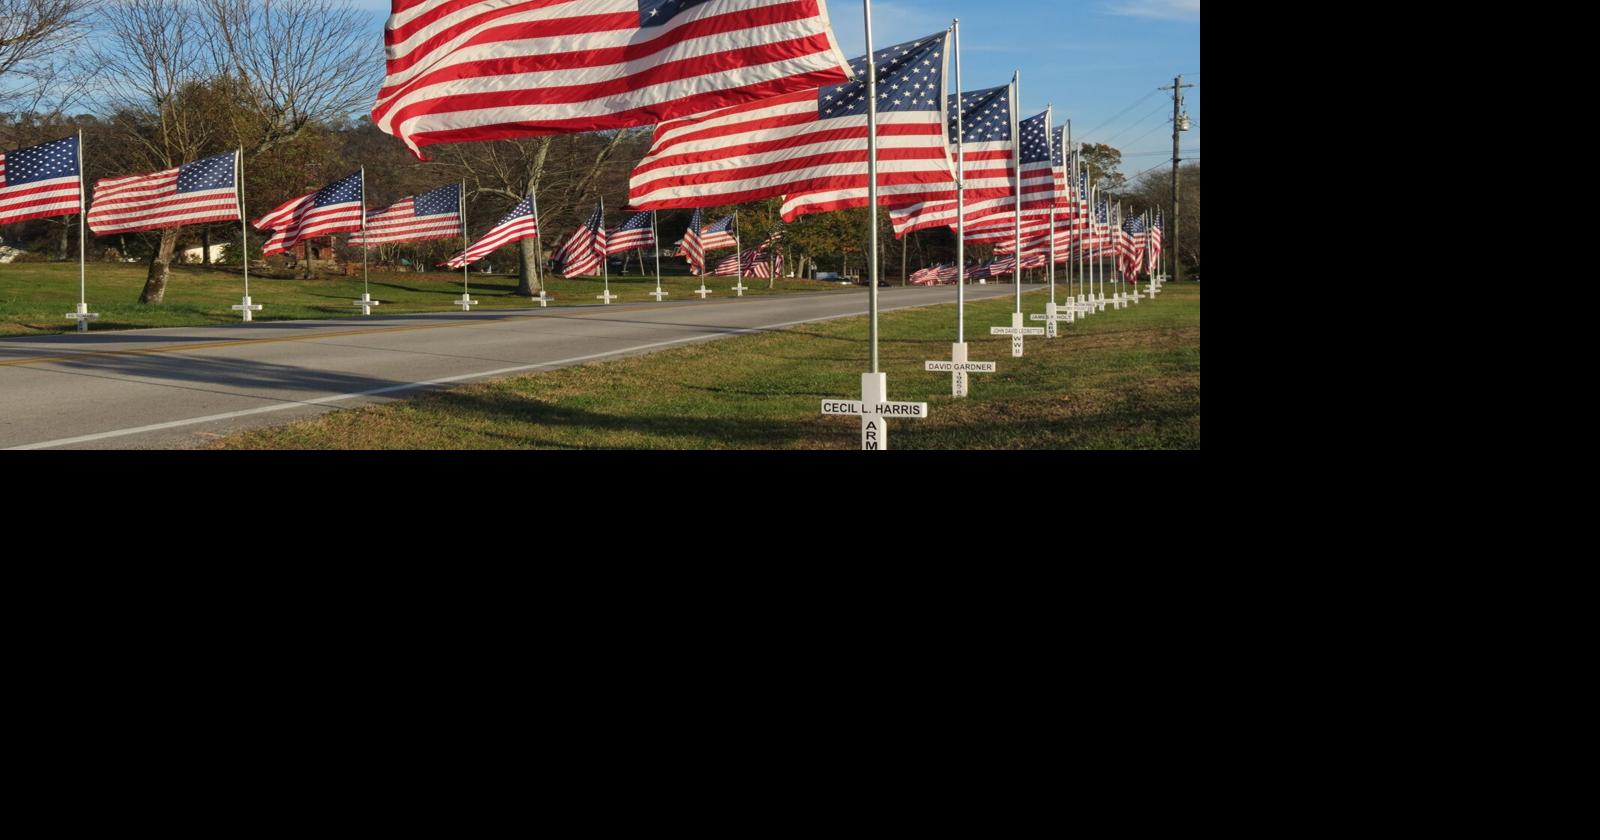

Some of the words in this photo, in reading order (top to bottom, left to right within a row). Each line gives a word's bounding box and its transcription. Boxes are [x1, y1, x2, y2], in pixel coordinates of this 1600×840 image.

[953, 363, 992, 371] GARDNER
[823, 402, 858, 414] CECIL
[861, 403, 872, 414] L.
[875, 404, 920, 415] HARRIS
